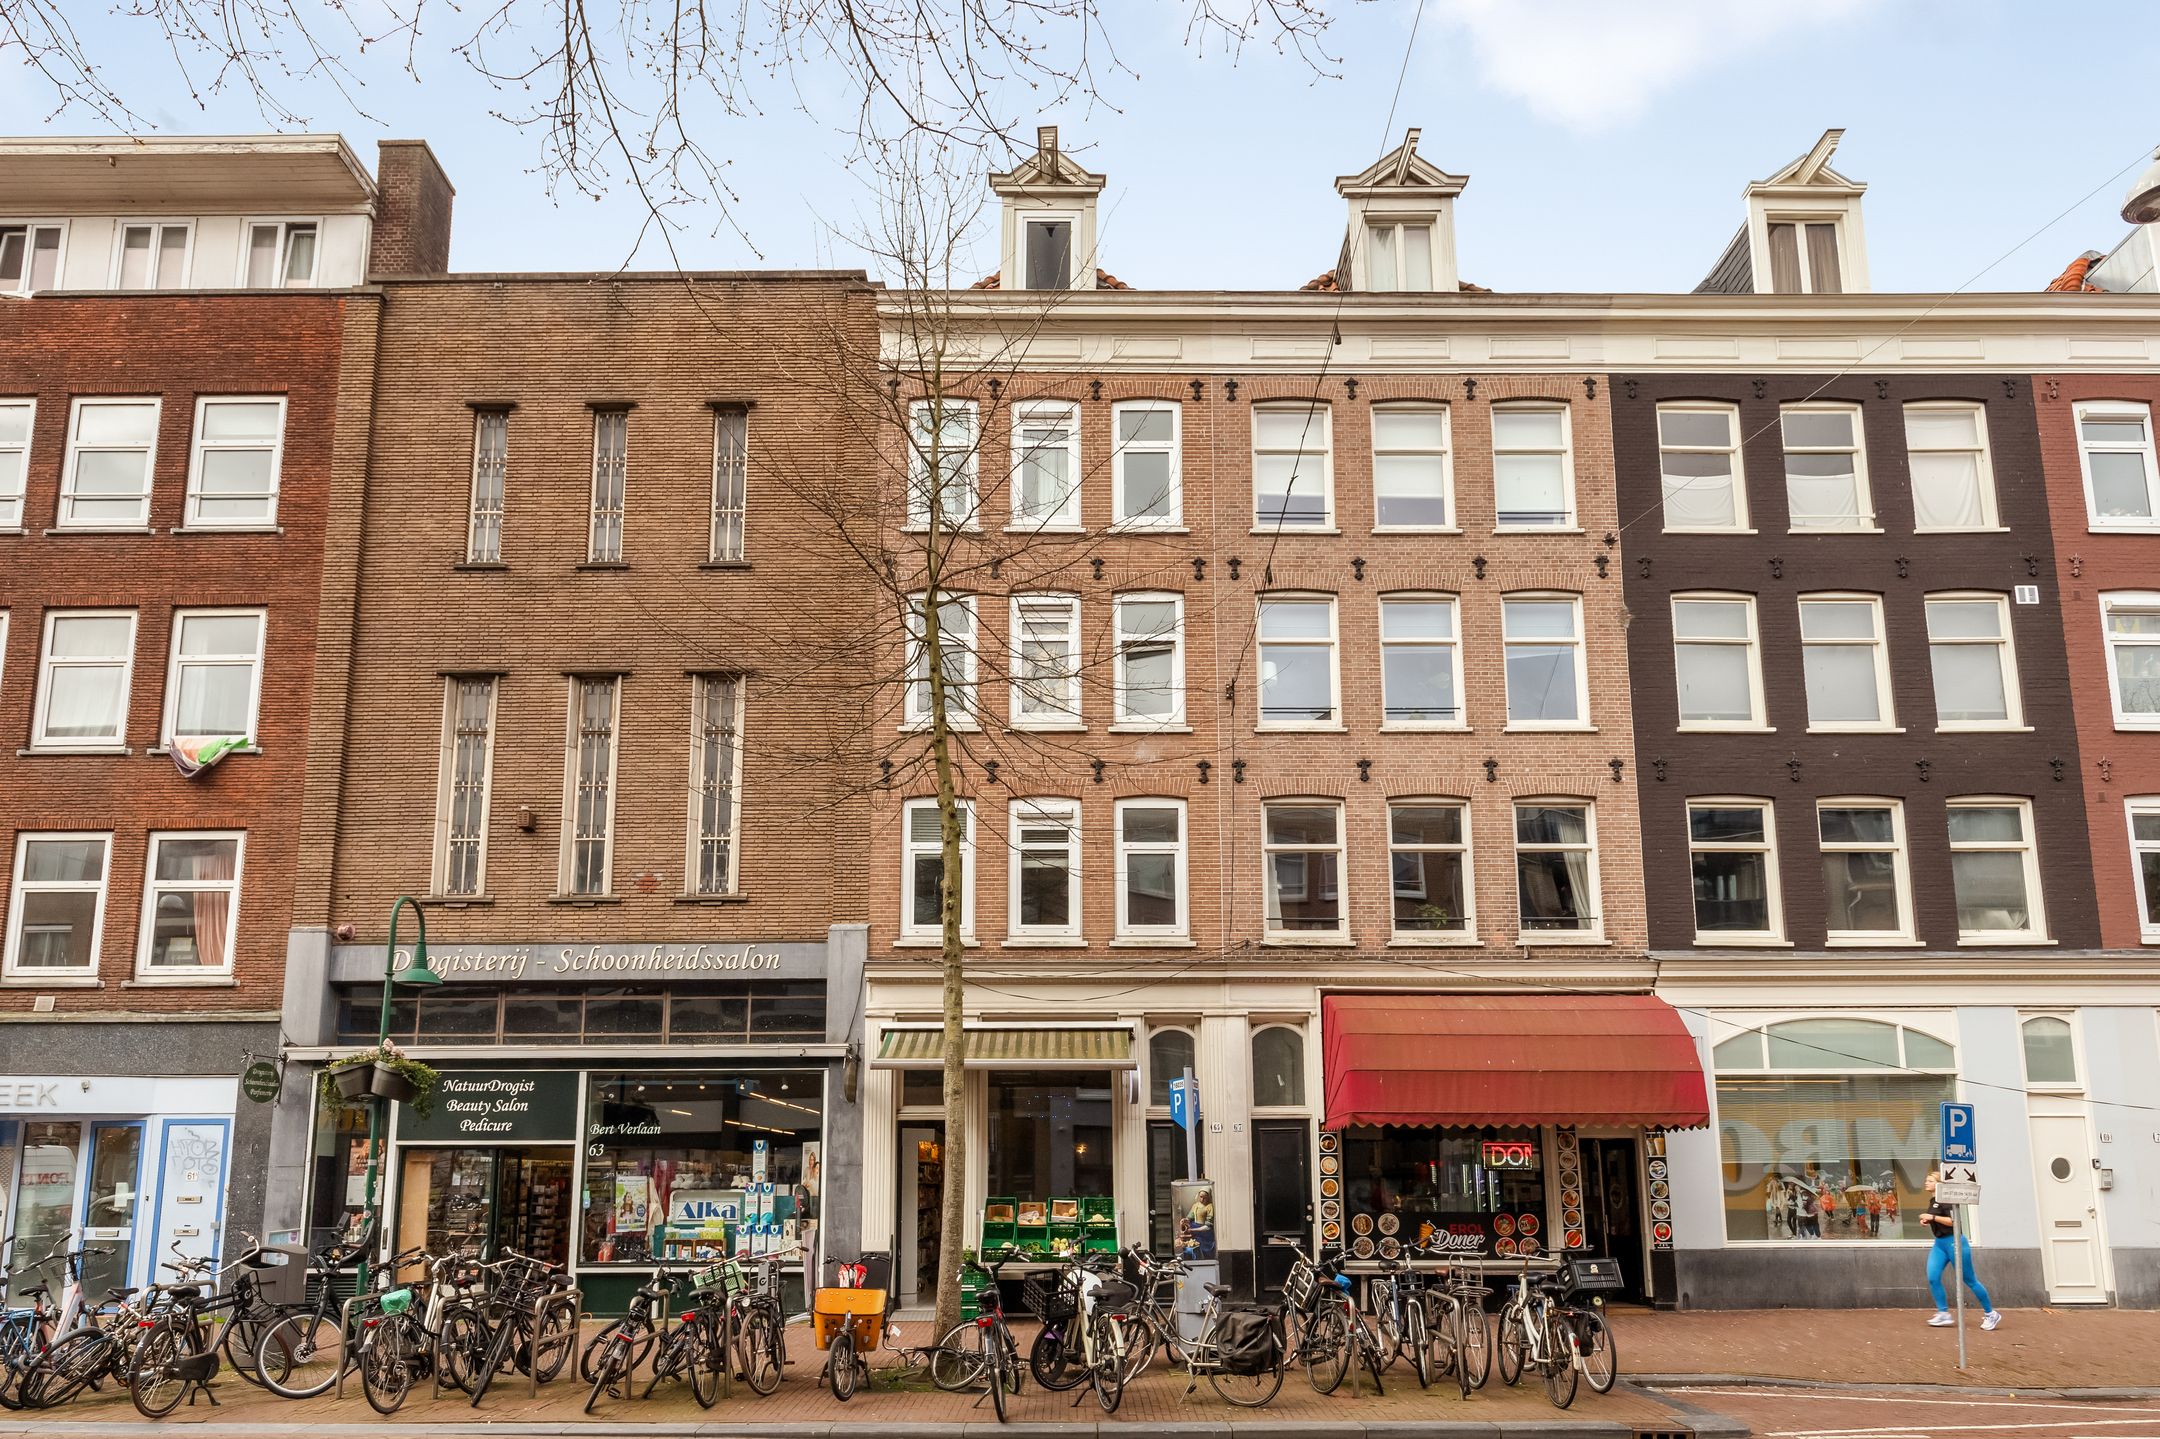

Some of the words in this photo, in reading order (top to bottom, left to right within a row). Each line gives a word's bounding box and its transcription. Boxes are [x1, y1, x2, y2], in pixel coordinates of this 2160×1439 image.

[393, 948, 530, 979] Dogisterij
[553, 945, 781, 974] Schoonheidssalon
[442, 1079, 535, 1096] NatuurDrogist
[446, 1099, 491, 1116] Beauty
[492, 1097, 529, 1112] Salon
[1174, 1093, 1181, 1113] P
[460, 1117, 513, 1132] Pedicure
[589, 1123, 615, 1135] Bert
[617, 1122, 662, 1135] Verlaan
[1949, 1108, 1968, 1138] P
[588, 1143, 605, 1157] 63
[677, 1200, 738, 1219] Alka
[1449, 1223, 1485, 1234] EROL
[1431, 1229, 1486, 1249] Doner
